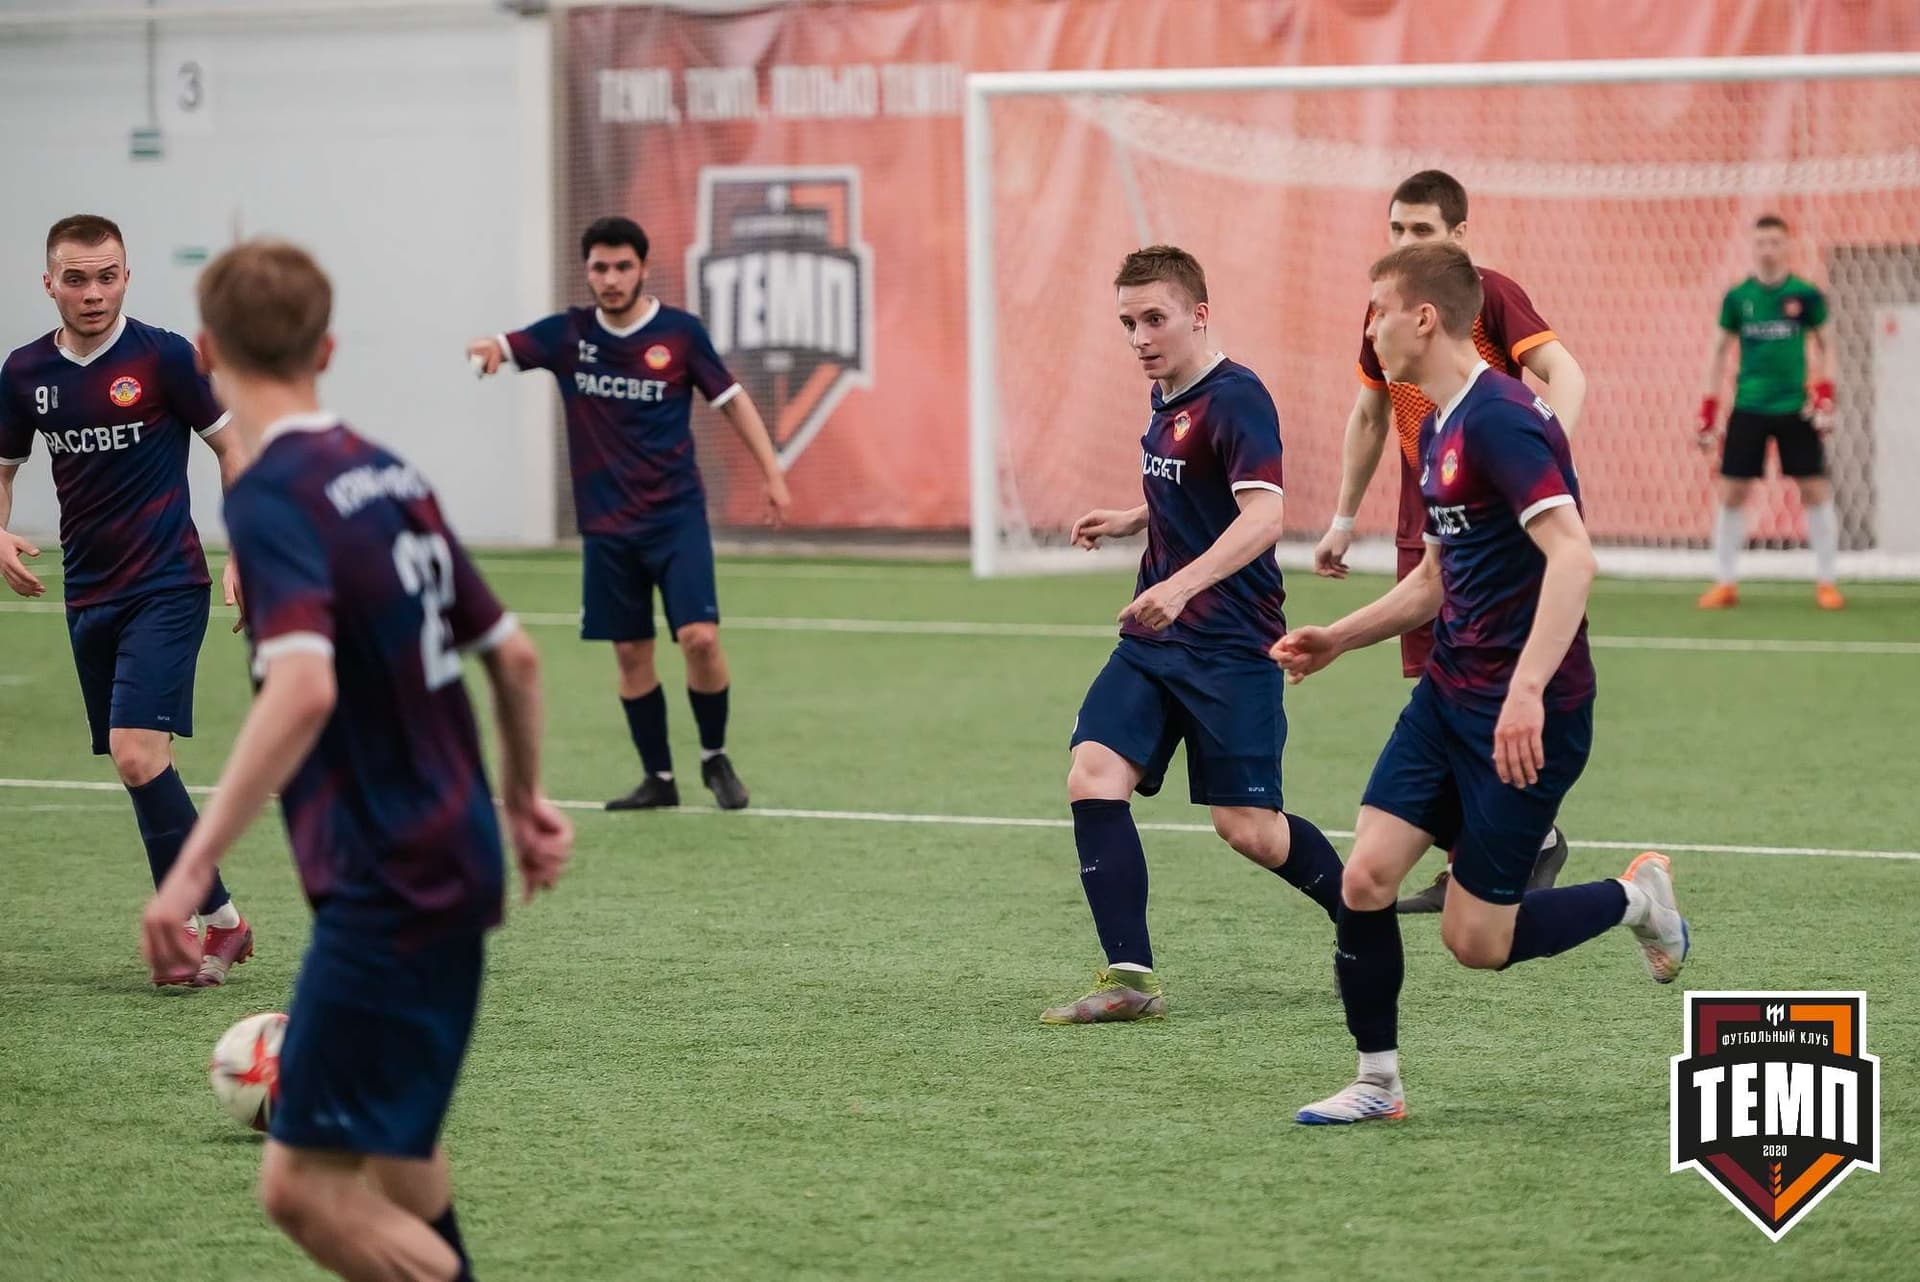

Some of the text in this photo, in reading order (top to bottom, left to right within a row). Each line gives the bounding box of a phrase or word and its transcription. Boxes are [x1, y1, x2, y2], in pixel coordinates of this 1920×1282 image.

[178, 60, 204, 113] 3
[702, 250, 858, 358] ТЕМП
[574, 371, 668, 402] РАССВЕТ
[46, 421, 144, 456] РАССВЕТ
